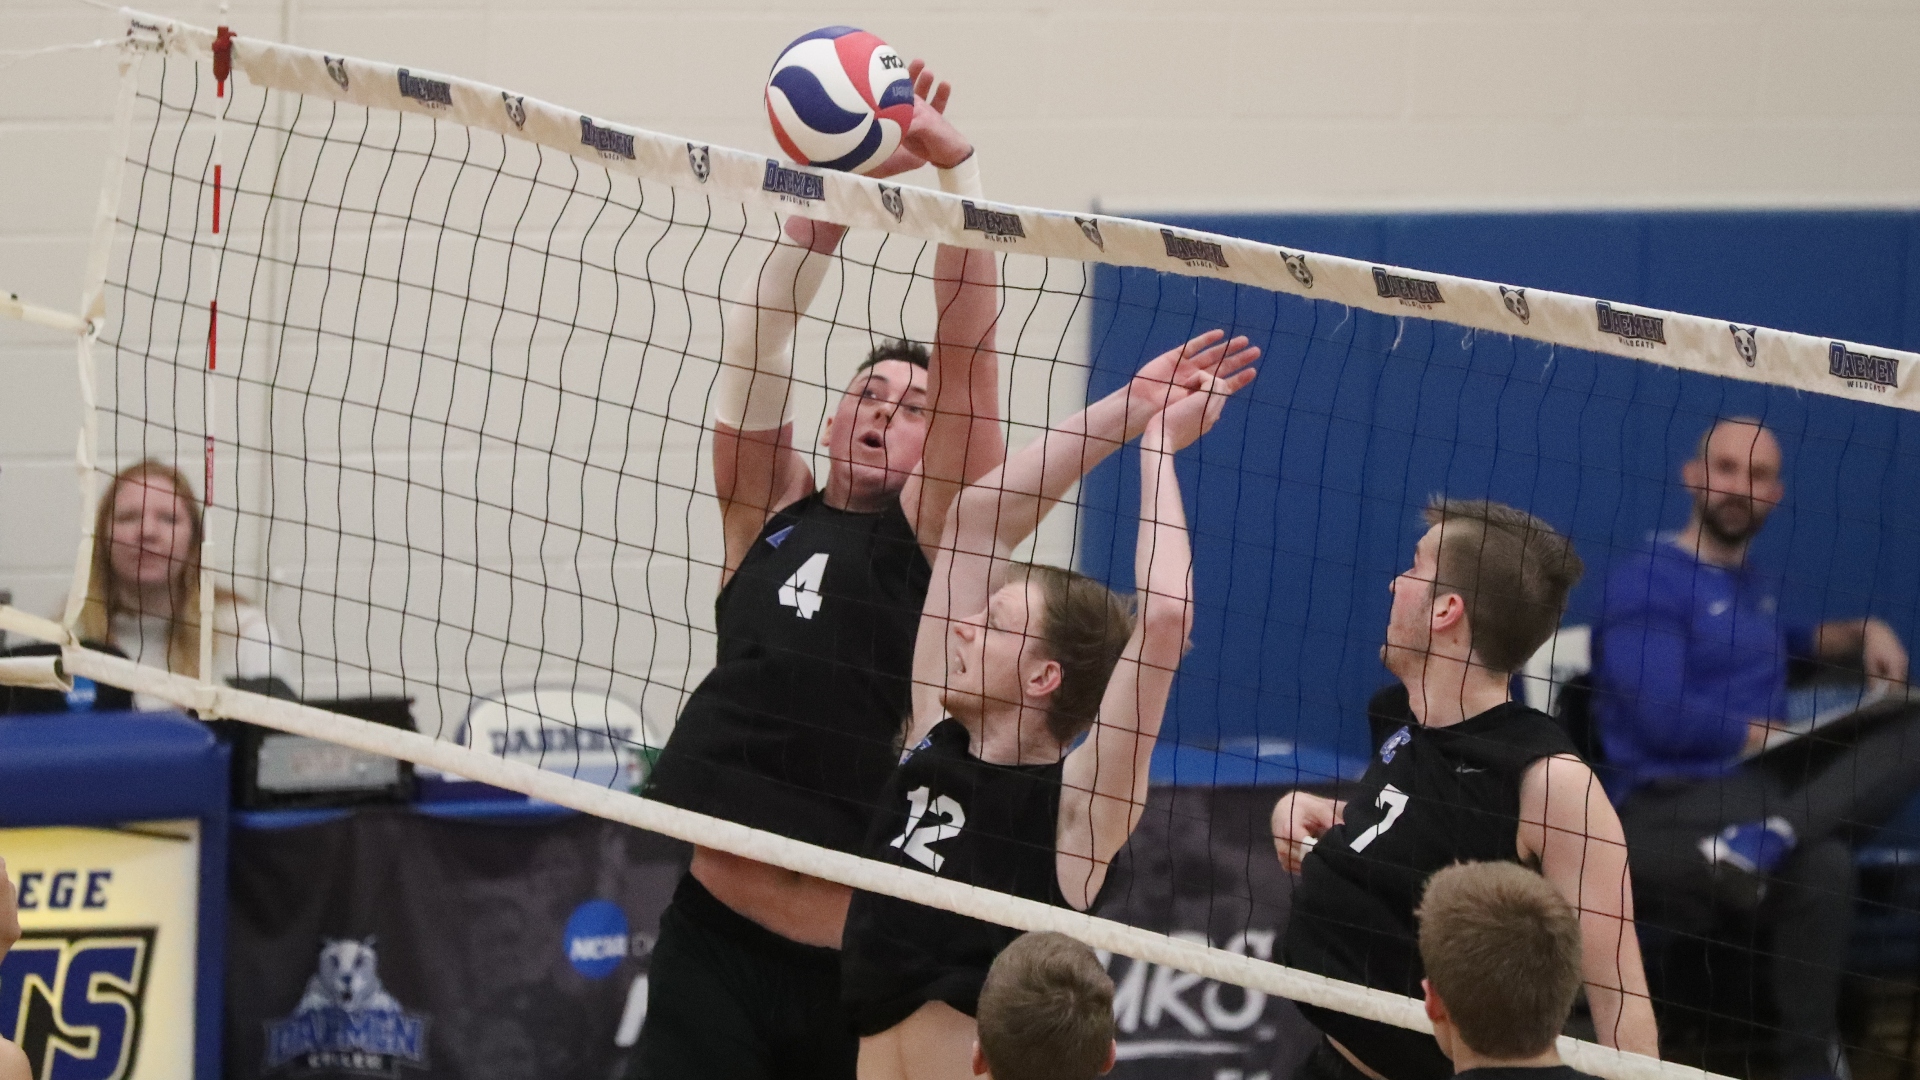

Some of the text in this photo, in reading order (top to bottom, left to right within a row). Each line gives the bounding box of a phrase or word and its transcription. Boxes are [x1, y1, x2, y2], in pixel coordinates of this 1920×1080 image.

[763, 159, 825, 201] DAEMEN
[1372, 267, 1445, 303] DAEMEN
[1596, 300, 1666, 345] DAEMEN
[1619, 337, 1655, 349] WILDCATS
[1829, 341, 1899, 388] DAEMEN
[1846, 380, 1886, 393] WILDCATS
[778, 552, 830, 619] 4
[890, 785, 966, 873] 12
[1349, 783, 1410, 854] 7
